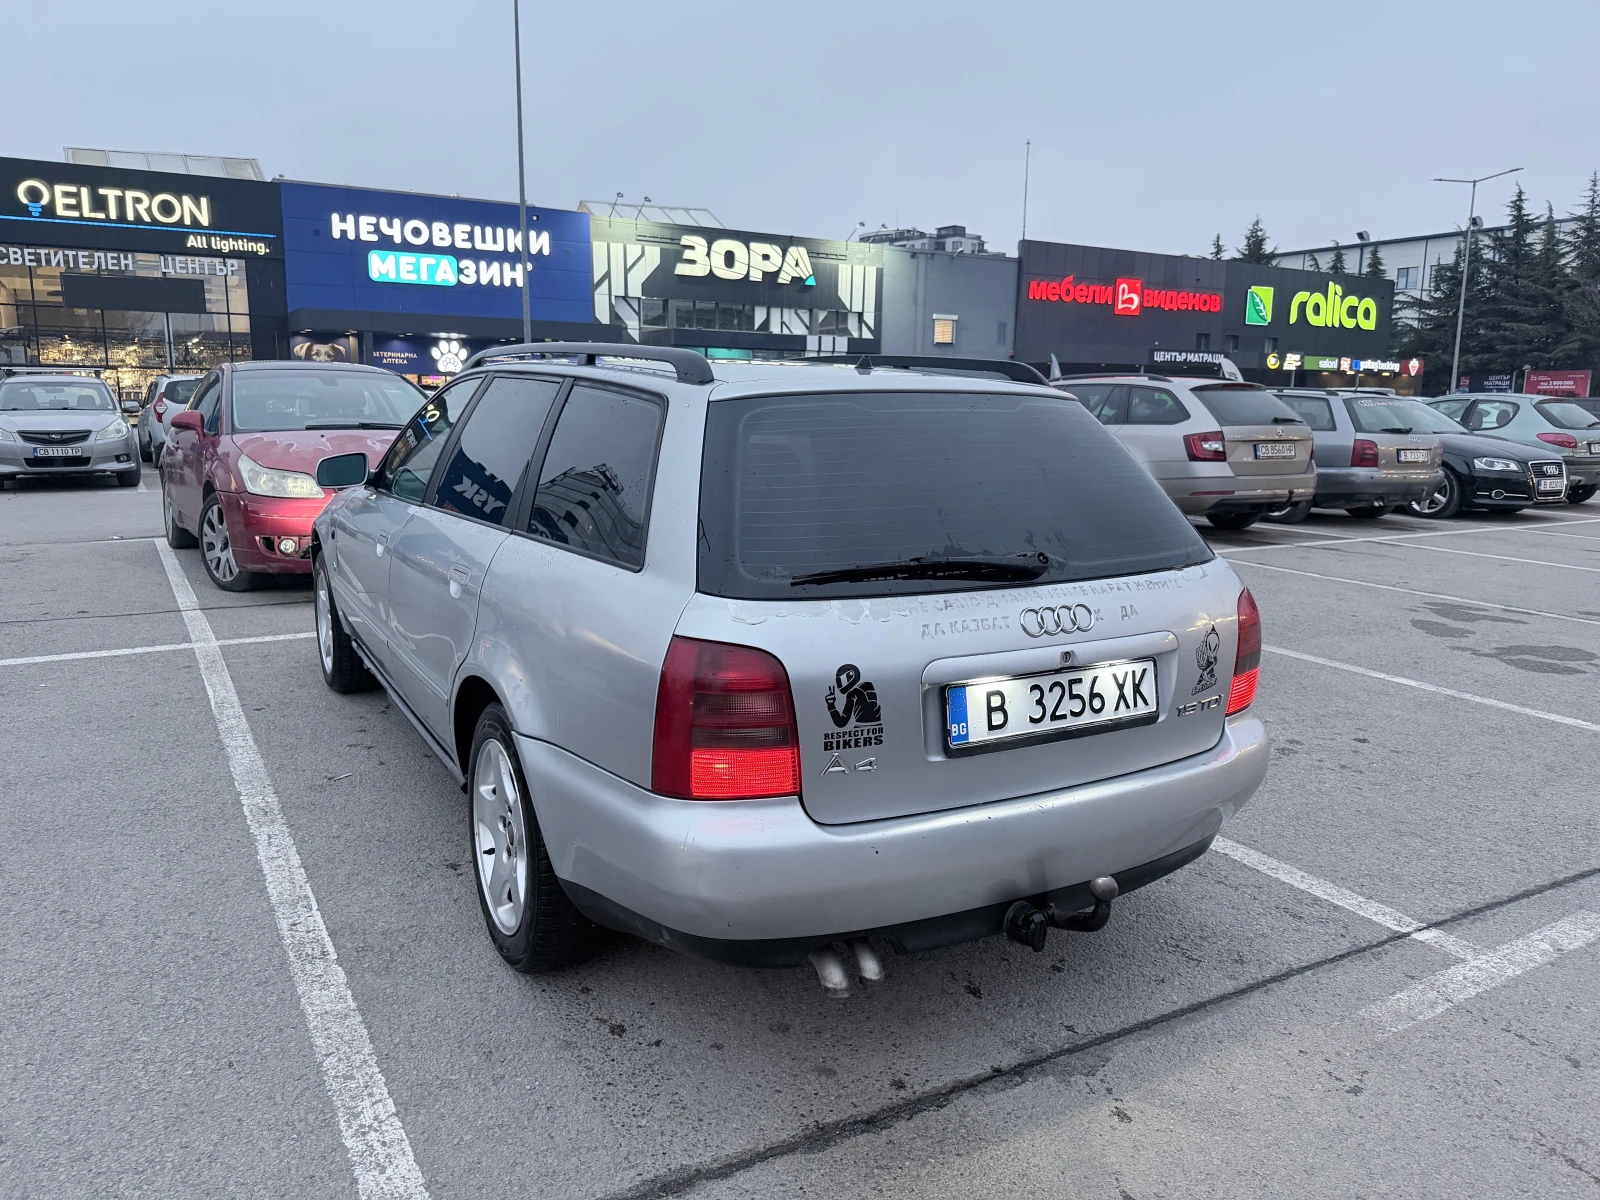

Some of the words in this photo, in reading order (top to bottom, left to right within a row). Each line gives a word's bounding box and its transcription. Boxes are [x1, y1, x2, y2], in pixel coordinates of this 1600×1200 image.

[331, 213, 550, 256] НЕЧОВЕШКИ
[187, 235, 207, 249] All
[211, 236, 270, 255] lighting.
[160, 256, 238, 276] ЦЕНТЪР
[674, 235, 816, 286] ЗОРА
[1028, 275, 1113, 304] мебели
[1143, 289, 1222, 313] виденов
[1289, 281, 1376, 330] ralica
[373, 351, 417, 359] ВЕТЕРИНАРНА
[1154, 351, 1186, 362] ЦЕНТЪР
[70, 447, 80, 455] TP
[1261, 446, 1270, 455] CB
[1119, 604, 1139, 621] ДА
[951, 722, 967, 737] BG
[985, 689, 1009, 731] B
[1028, 675, 1106, 724] 3256
[1112, 668, 1149, 712] XK
[824, 729, 865, 740] RESPECT
[866, 727, 884, 737] FOR
[823, 735, 884, 751] BIKERS
